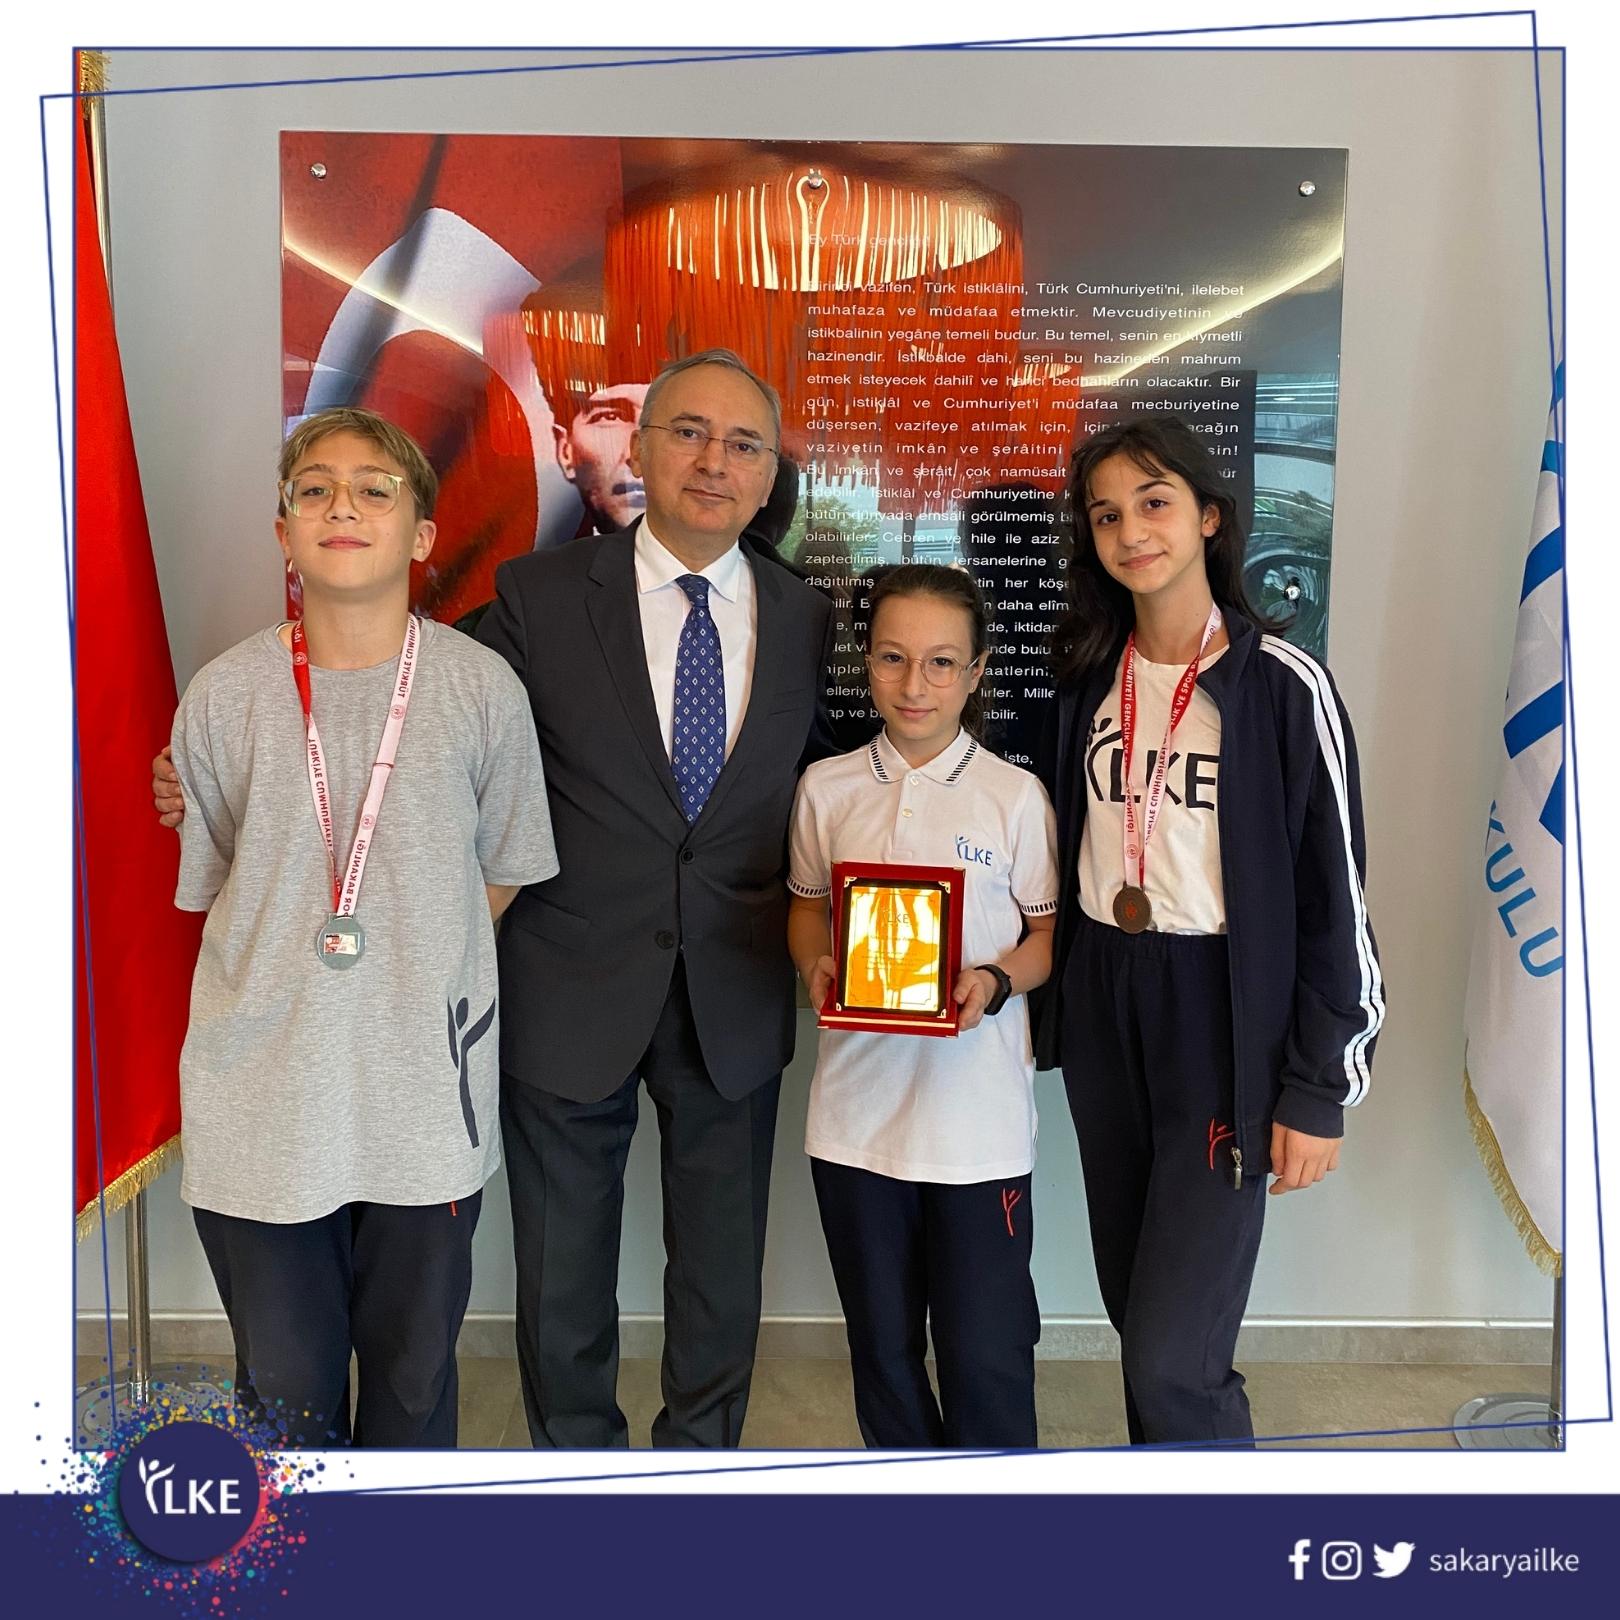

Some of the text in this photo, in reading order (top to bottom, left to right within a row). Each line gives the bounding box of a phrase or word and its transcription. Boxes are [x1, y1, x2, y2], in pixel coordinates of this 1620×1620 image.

[808, 281, 1245, 298] irinci vazifen, Türk istiklâlini, Türk Cumhuriyeti'ni, ilelebet
[808, 305, 885, 317] muhafaza
[898, 307, 916, 317] ve
[929, 305, 998, 317] müdafaa
[1010, 306, 1079, 318] etmektir.
[1092, 306, 1212, 320] Mevcudiyetinin
[807, 328, 883, 340] istikbalinin
[888, 328, 941, 342] yegâne
[946, 329, 990, 340] temeli
[994, 328, 1039, 341] budur.
[1045, 329, 1065, 341] Bu
[1070, 330, 1114, 342] temel,
[1119, 330, 1158, 342] senin
[1163, 332, 1181, 342] en
[807, 351, 886, 363] hazinendir.
[977, 352, 1012, 365] dahi,
[1023, 353, 1054, 364] seni
[1064, 353, 1083, 364] bu
[1094, 353, 1170, 364] hazineden
[1181, 354, 1241, 365] mahrum
[807, 374, 851, 385] etmek
[859, 374, 926, 387] isteyecek
[934, 375, 974, 386] dahilî
[981, 377, 999, 386] ve
[1146, 376, 1212, 388] olacaktır.
[1220, 377, 1241, 388] Bir
[806, 397, 1240, 413] gün, istiklâl ve Cumhuriyet'i müdafaa mecburiyetine
[806, 420, 882, 433] düşersen,
[895, 421, 959, 434] vazifeye
[971, 421, 1027, 432] atılmak
[1040, 422, 1071, 436] için,
[806, 443, 883, 456] vaziyetin
[896, 443, 946, 455] imkân
[960, 445, 979, 455] ve
[992, 444, 1063, 457] şerâitini
[887, 467, 904, 476] ve
[966, 466, 991, 479] çok
[1000, 466, 1067, 477] namüsait
[924, 489, 942, 499] ve
[951, 488, 1055, 501] Cumhuriyetine
[806, 509, 846, 521] bütün
[852, 510, 913, 523] dünyada
[919, 510, 966, 521] emsali
[971, 511, 1055, 524] görülmemiş
[882, 532, 936, 543] Cebren
[944, 534, 962, 544] ve
[971, 533, 996, 544] hile
[1005, 533, 1022, 544] ile
[1031, 534, 1060, 544] aziz
[805, 553, 889, 567] zaptedilmiş,
[901, 554, 942, 566] bütün
[954, 555, 1047, 567] tersanelerine
[805, 575, 875, 589] dağıtılmış
[1004, 577, 1029, 588] her
[997, 599, 1034, 611] daha
[1180, 671, 1196, 694] SPOR
[848, 709, 865, 718] ve
